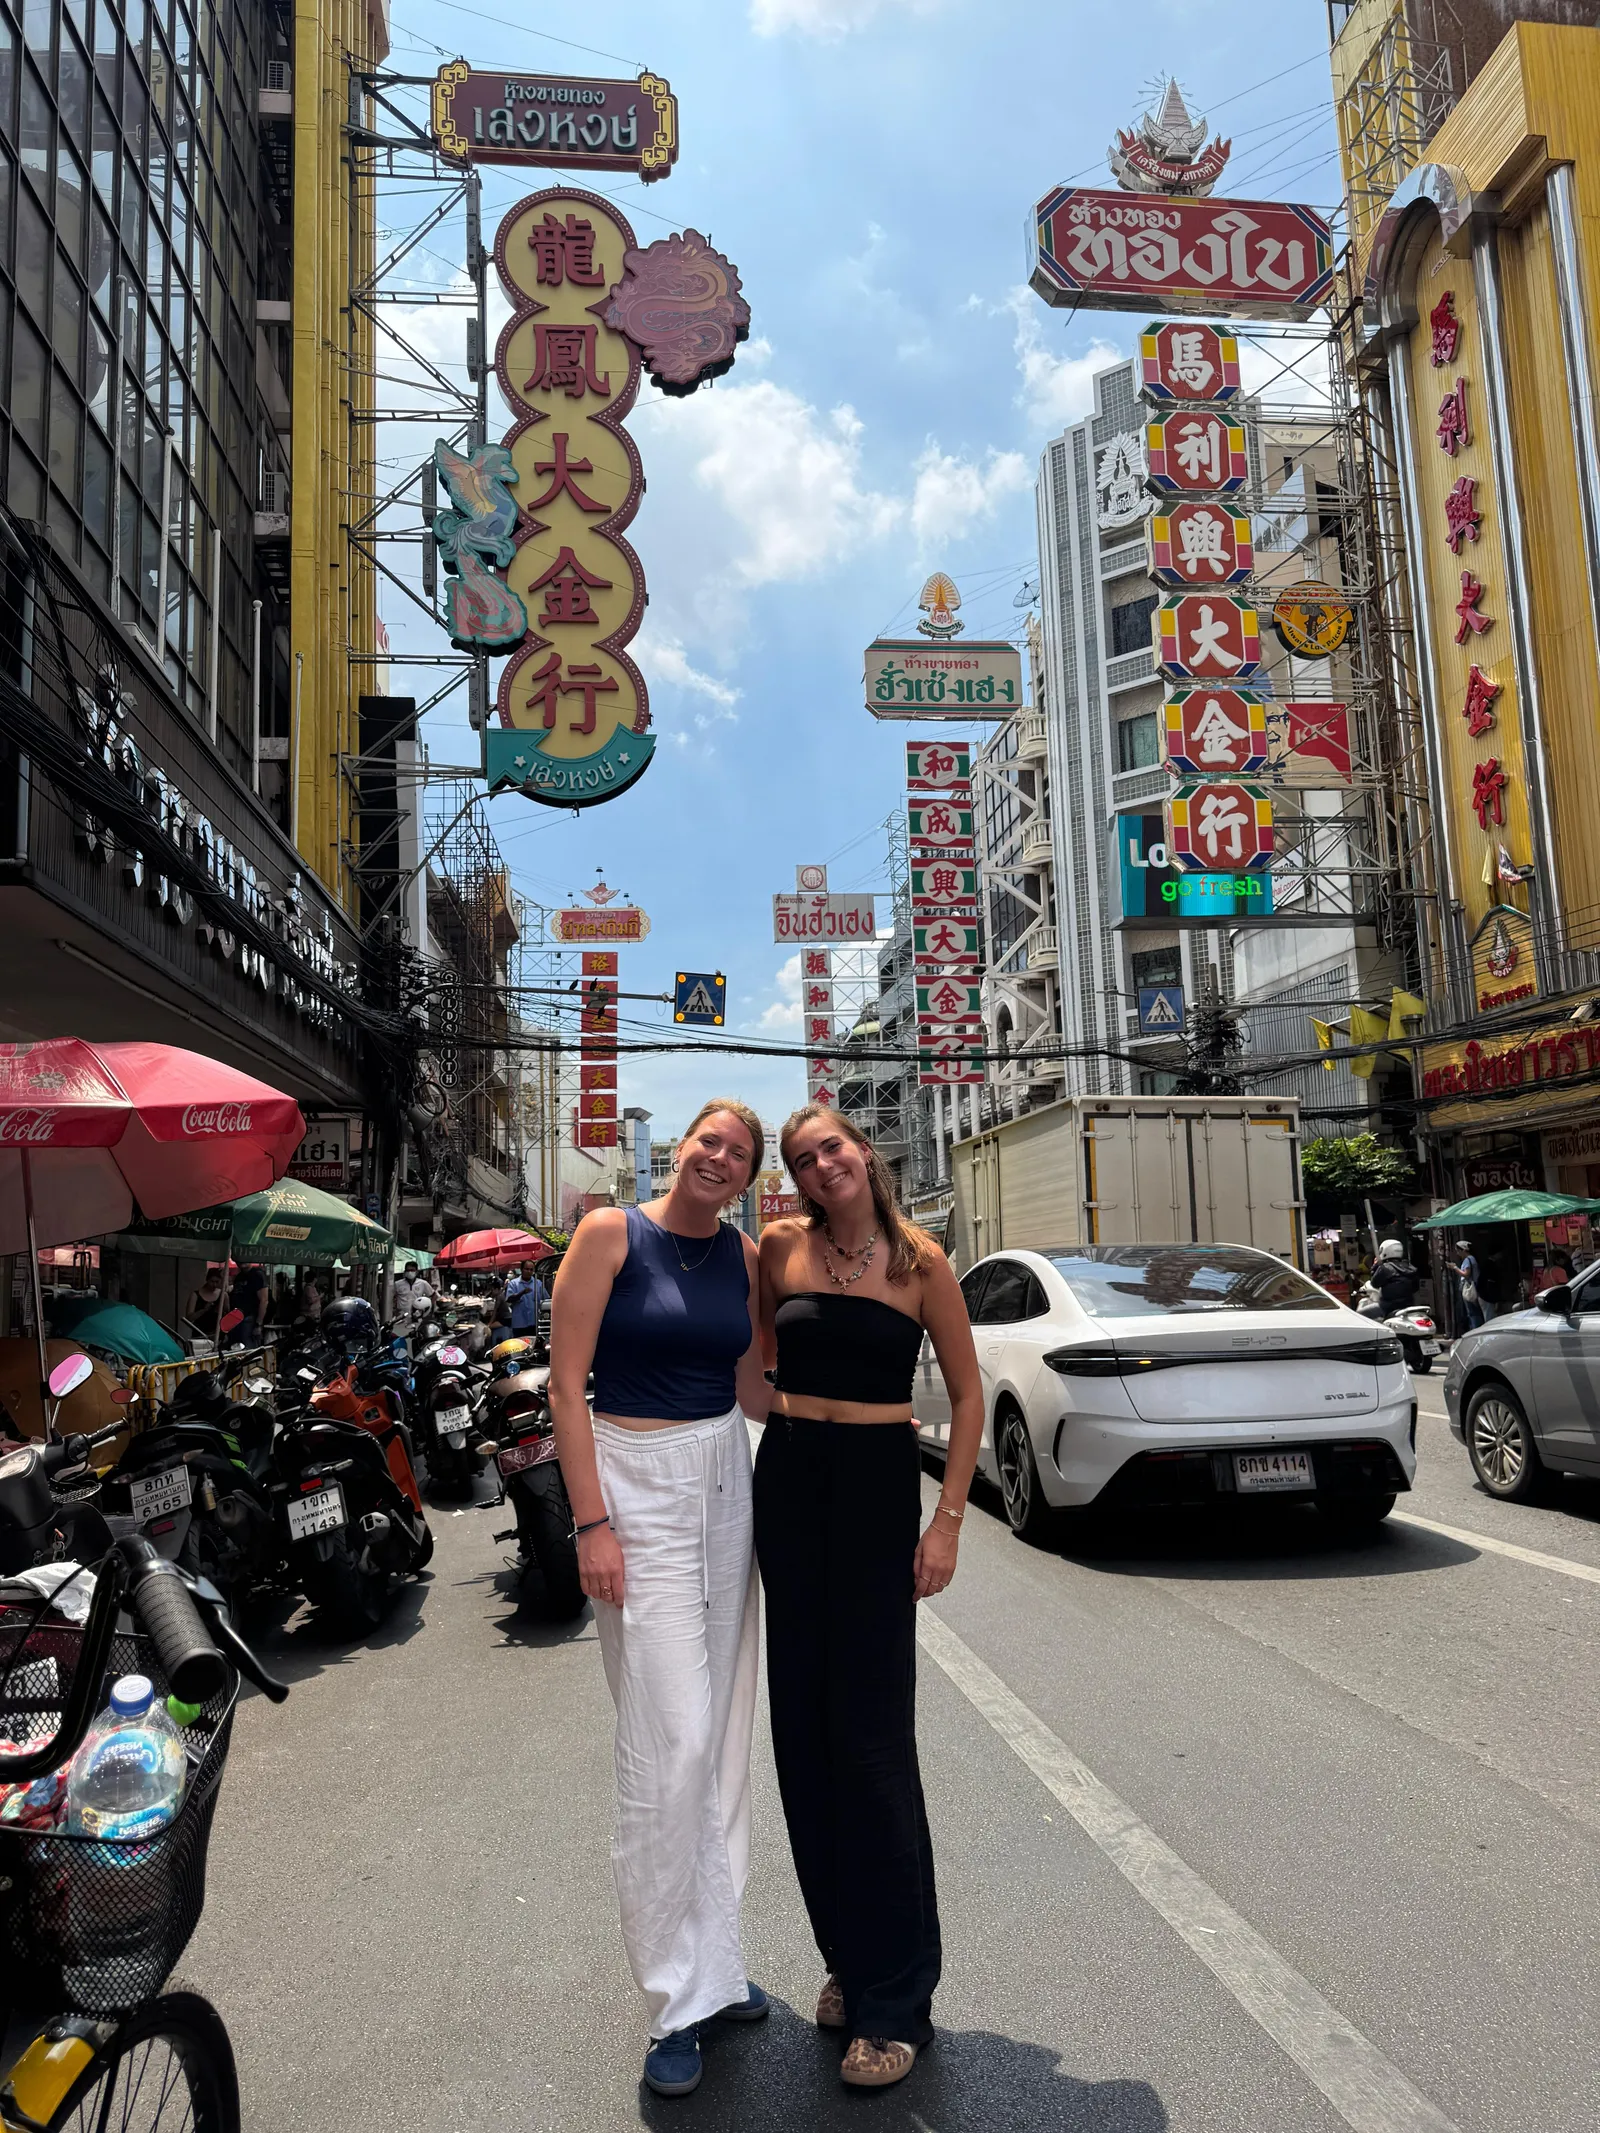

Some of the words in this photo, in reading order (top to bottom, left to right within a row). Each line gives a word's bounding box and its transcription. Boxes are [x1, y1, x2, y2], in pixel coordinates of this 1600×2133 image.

[503, 80, 606, 104] ห้างขายทอง
[473, 100, 638, 149] เล่งหงษ์
[1068, 197, 1182, 230] ห้างทอง
[1066, 210, 1306, 292] ทองใบ
[523, 212, 620, 735] 龍鳳大金行
[1168, 331, 1251, 860] 馬利興大金行
[904, 655, 979, 671] ห้างขายทอง
[1161, 879, 1193, 902] go
[1199, 876, 1263, 896] fresh
[182, 1102, 253, 1135] Coca-Cola
[762, 1198, 780, 1213] 24
[1231, 1335, 1288, 1347] BYD
[1272, 1456, 1307, 1472] 4114
[142, 1495, 181, 1518] 6165
[301, 1515, 338, 1537] 1143
